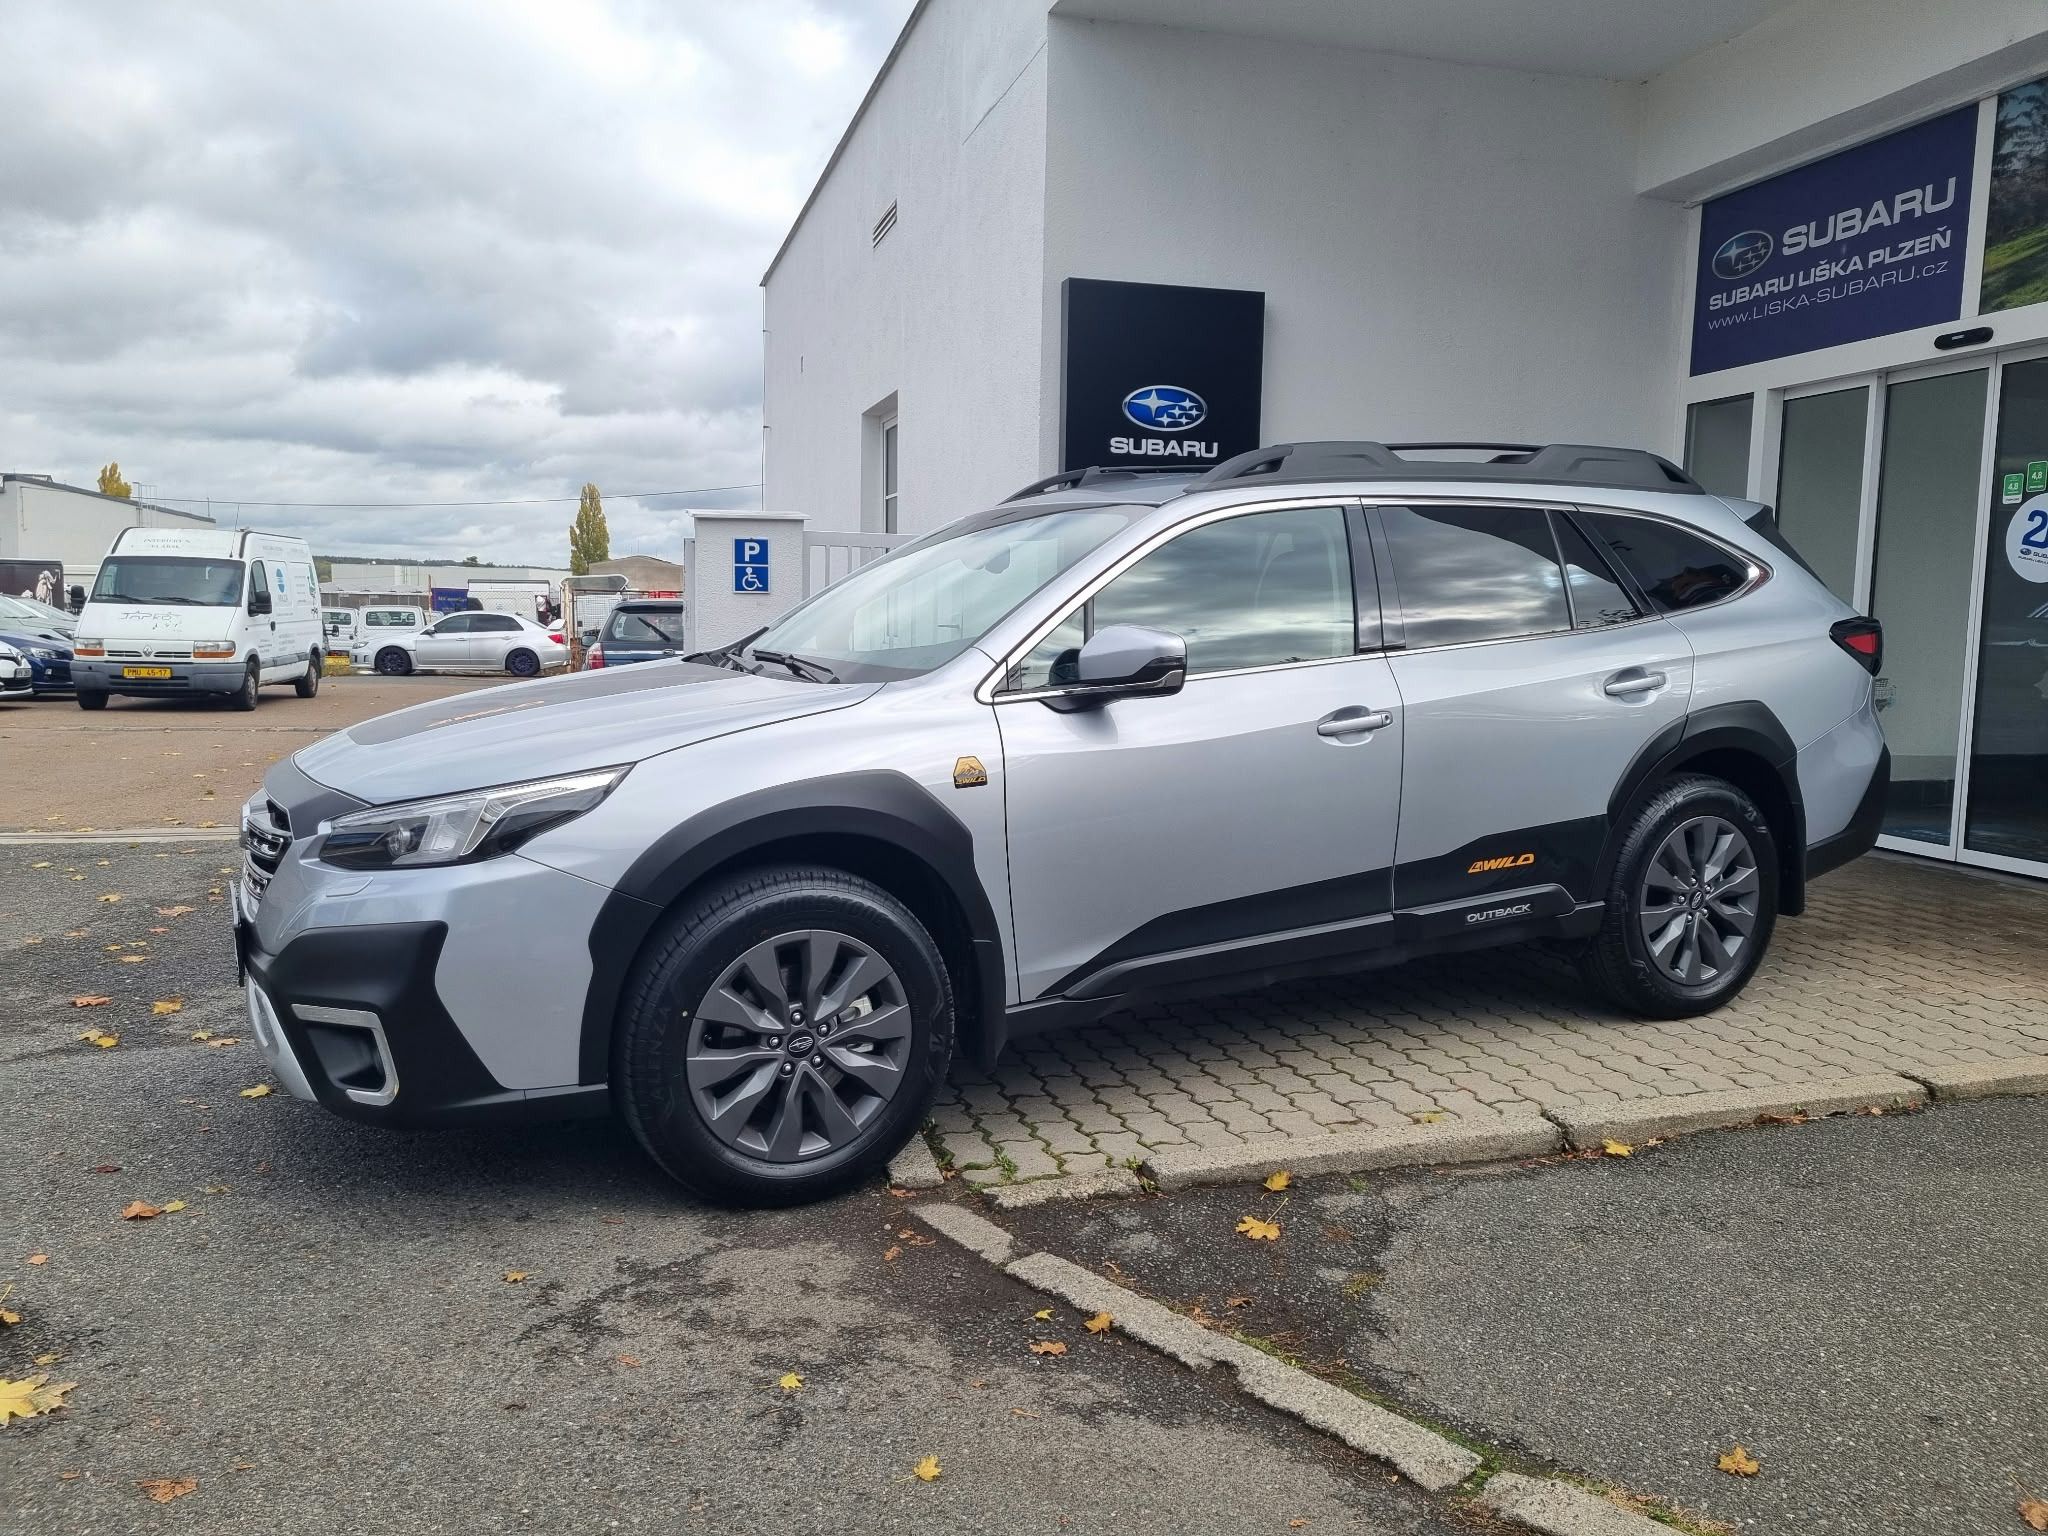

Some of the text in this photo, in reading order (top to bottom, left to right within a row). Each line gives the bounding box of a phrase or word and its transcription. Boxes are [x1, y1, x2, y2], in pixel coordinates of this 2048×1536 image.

[1782, 177, 1957, 256] SUBARU
[1709, 226, 1952, 311] SUBARU LIŠKA PLZEŇ
[1708, 260, 1949, 330] www.LISKA-SUBARU.cz
[1110, 436, 1219, 458] SUBARU
[744, 541, 760, 562] P
[146, 668, 167, 677] 45-17
[1466, 903, 1531, 922] OUTBACK
